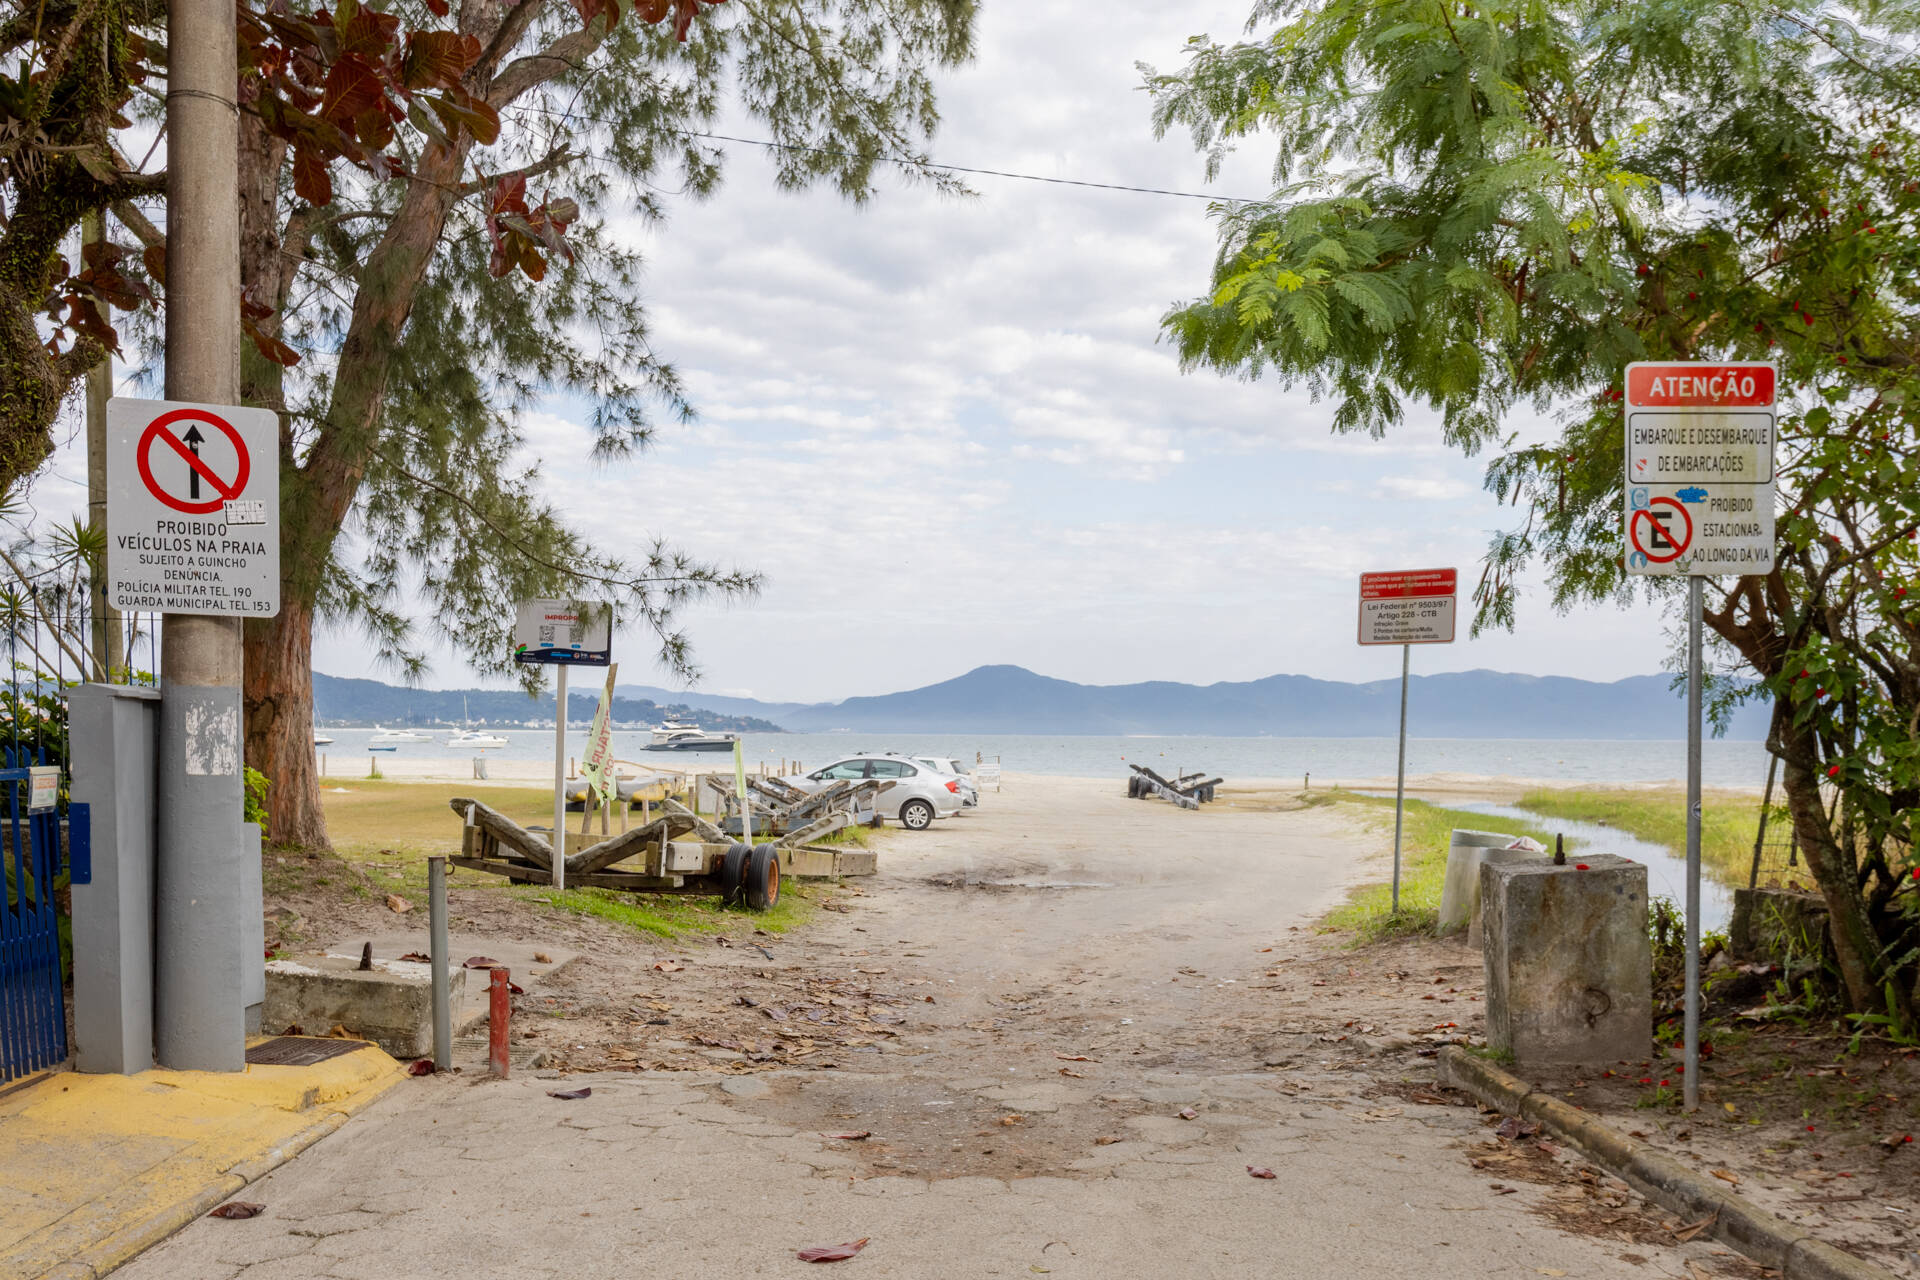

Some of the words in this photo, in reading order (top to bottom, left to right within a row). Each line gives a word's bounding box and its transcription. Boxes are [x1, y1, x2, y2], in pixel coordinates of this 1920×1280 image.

[1649, 371, 1756, 402] ATENÇÃO
[1634, 428, 1688, 445] EMBARQUE
[1689, 429, 1696, 445] E
[1697, 428, 1768, 445] DESEMBARQUE
[1658, 456, 1671, 472] DE
[1673, 452, 1744, 476] EMBARCAÇÕES
[1710, 498, 1753, 512] PROIBIDO
[157, 520, 227, 537] PROIBIDO
[117, 532, 192, 552] VEÍCULOS
[196, 540, 217, 553] NA
[222, 540, 266, 555] PRAIA
[139, 554, 184, 566] SUJEITO
[187, 556, 195, 566] A
[198, 556, 247, 568] GUINCHO
[1692, 548, 1705, 562] AO
[1707, 548, 1738, 562] LONGO
[1740, 548, 1753, 562] DA
[1755, 548, 1770, 562] VIA
[117, 579, 161, 594] POLÍCIA
[164, 584, 207, 596] MILITAR
[209, 586, 231, 597] TEL.
[233, 587, 252, 597] 190
[117, 595, 164, 608] GUARDA
[167, 597, 226, 610] MUNICIPAL
[229, 600, 250, 611] TEL.
[252, 601, 271, 611] 153
[1367, 603, 1379, 611] Lei
[1380, 602, 1408, 610] Federal
[1418, 600, 1448, 608] 9503/97
[544, 614, 583, 622] IMPROPR
[1377, 611, 1400, 620] Artigo
